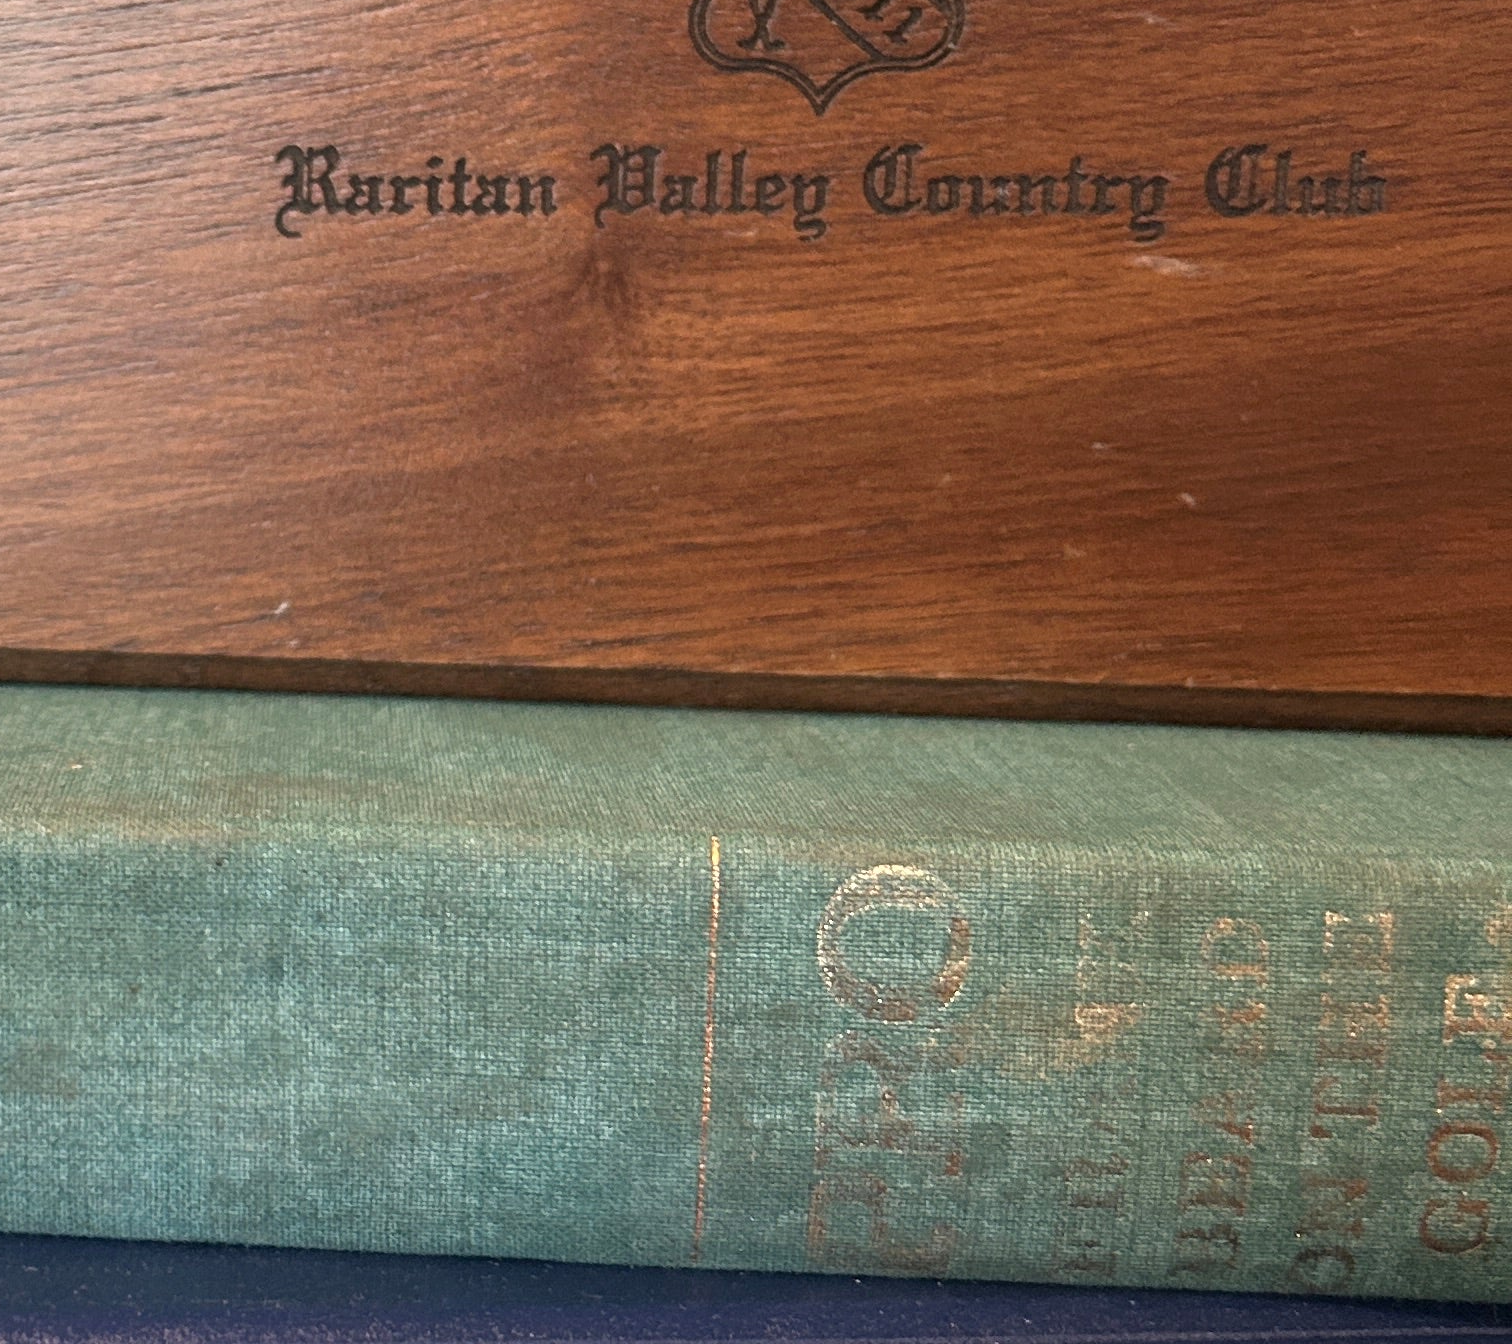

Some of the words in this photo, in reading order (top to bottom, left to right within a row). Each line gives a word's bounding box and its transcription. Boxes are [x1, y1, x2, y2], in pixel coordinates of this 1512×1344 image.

[275, 145, 558, 238] Raritan
[589, 143, 830, 240] Valley
[862, 143, 1169, 241] Country
[1204, 144, 1389, 217] Club
[806, 863, 972, 1270] PRO
[1310, 909, 1395, 1140] THE
[1419, 972, 1512, 1255] GOLF
